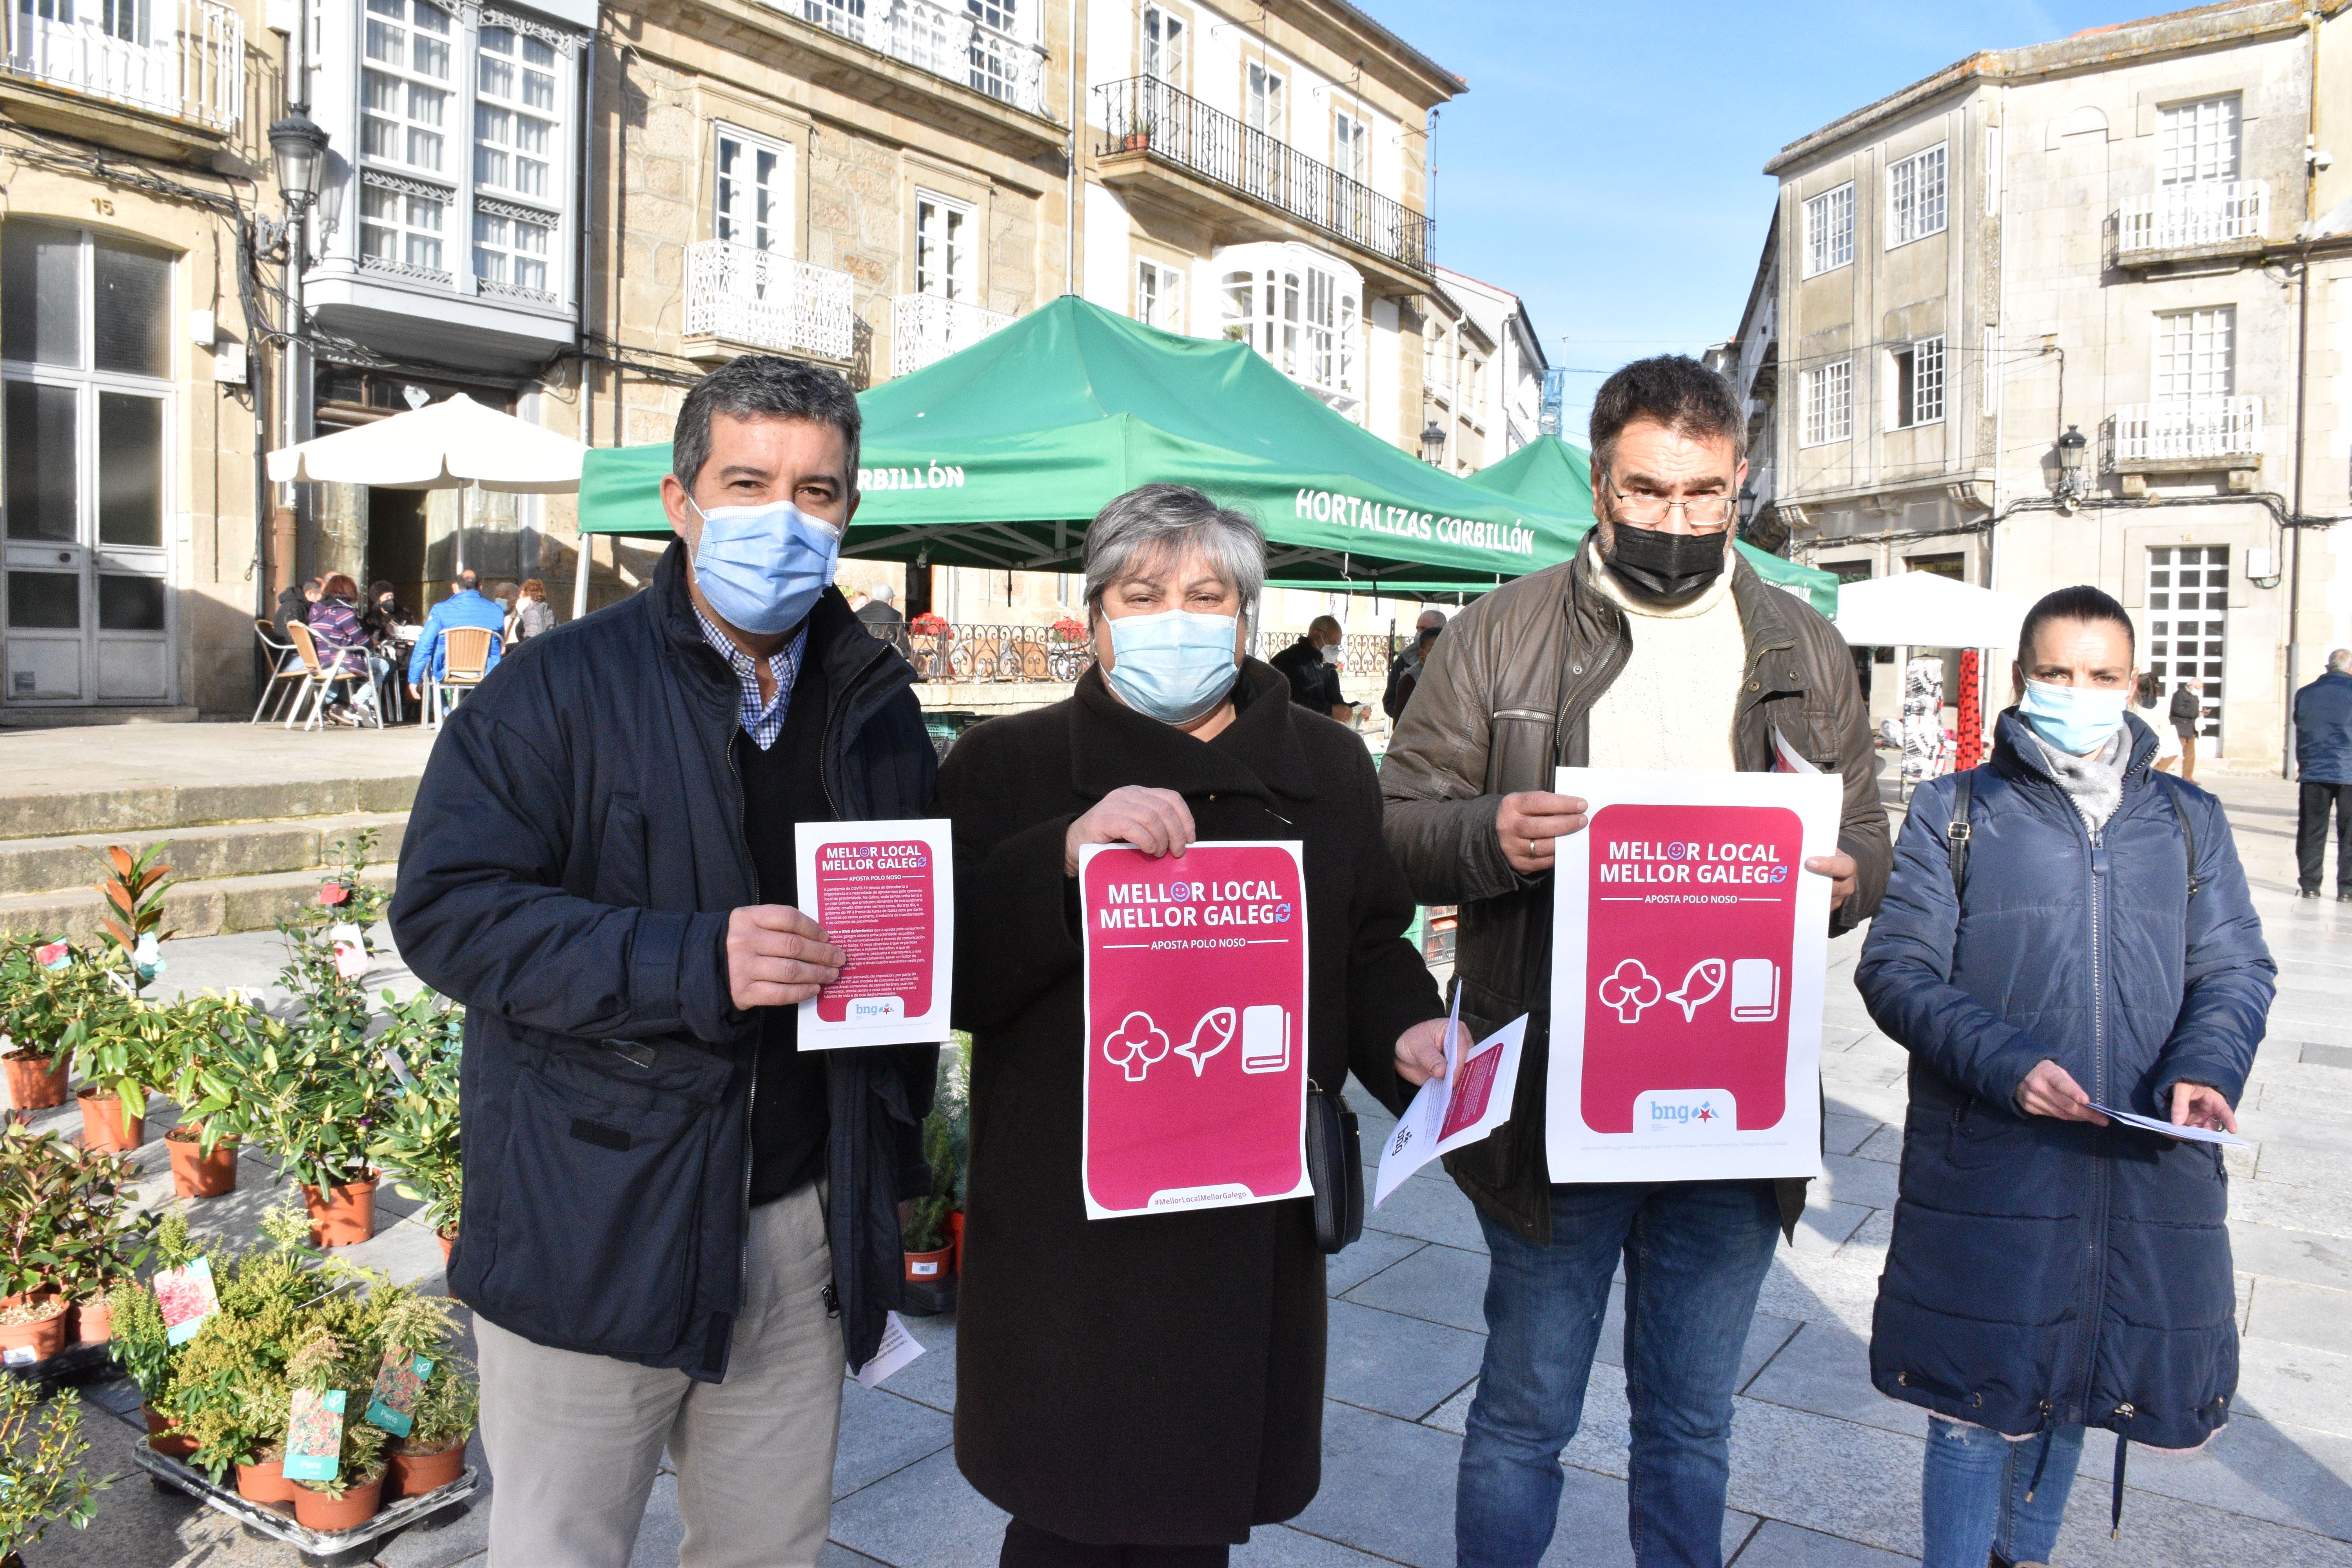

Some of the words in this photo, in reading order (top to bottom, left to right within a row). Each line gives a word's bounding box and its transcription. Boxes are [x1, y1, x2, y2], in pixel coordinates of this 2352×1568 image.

[91, 198, 115, 217] 15
[857, 459, 964, 491] RBILLÓN
[1296, 488, 1433, 540] HORTALIZAS
[1436, 519, 1535, 554] CORBILLÓN
[882, 846, 922, 857] LOCAL
[1707, 843, 1780, 862] LOCAL
[822, 859, 875, 871] MELLOR
[1601, 864, 1690, 883] MELLOR
[1212, 880, 1282, 901] LOCAL
[1644, 895, 1681, 904] APOSTA
[1683, 895, 1708, 903] POLO
[1711, 895, 1738, 904] NOSO
[1100, 906, 1198, 929] MELLOR
[1151, 940, 1189, 950] APOSTA
[1191, 939, 1216, 949] POLO
[1219, 938, 1246, 947] NOSO
[856, 1004, 878, 1015] bng
[1650, 1101, 1688, 1124] bng
[1392, 1124, 1408, 1156] bng
[1155, 1191, 1247, 1205] #MellorLocalMellorGalego
[380, 1409, 398, 1424] Pieris
[300, 1460, 322, 1469] Pieris
